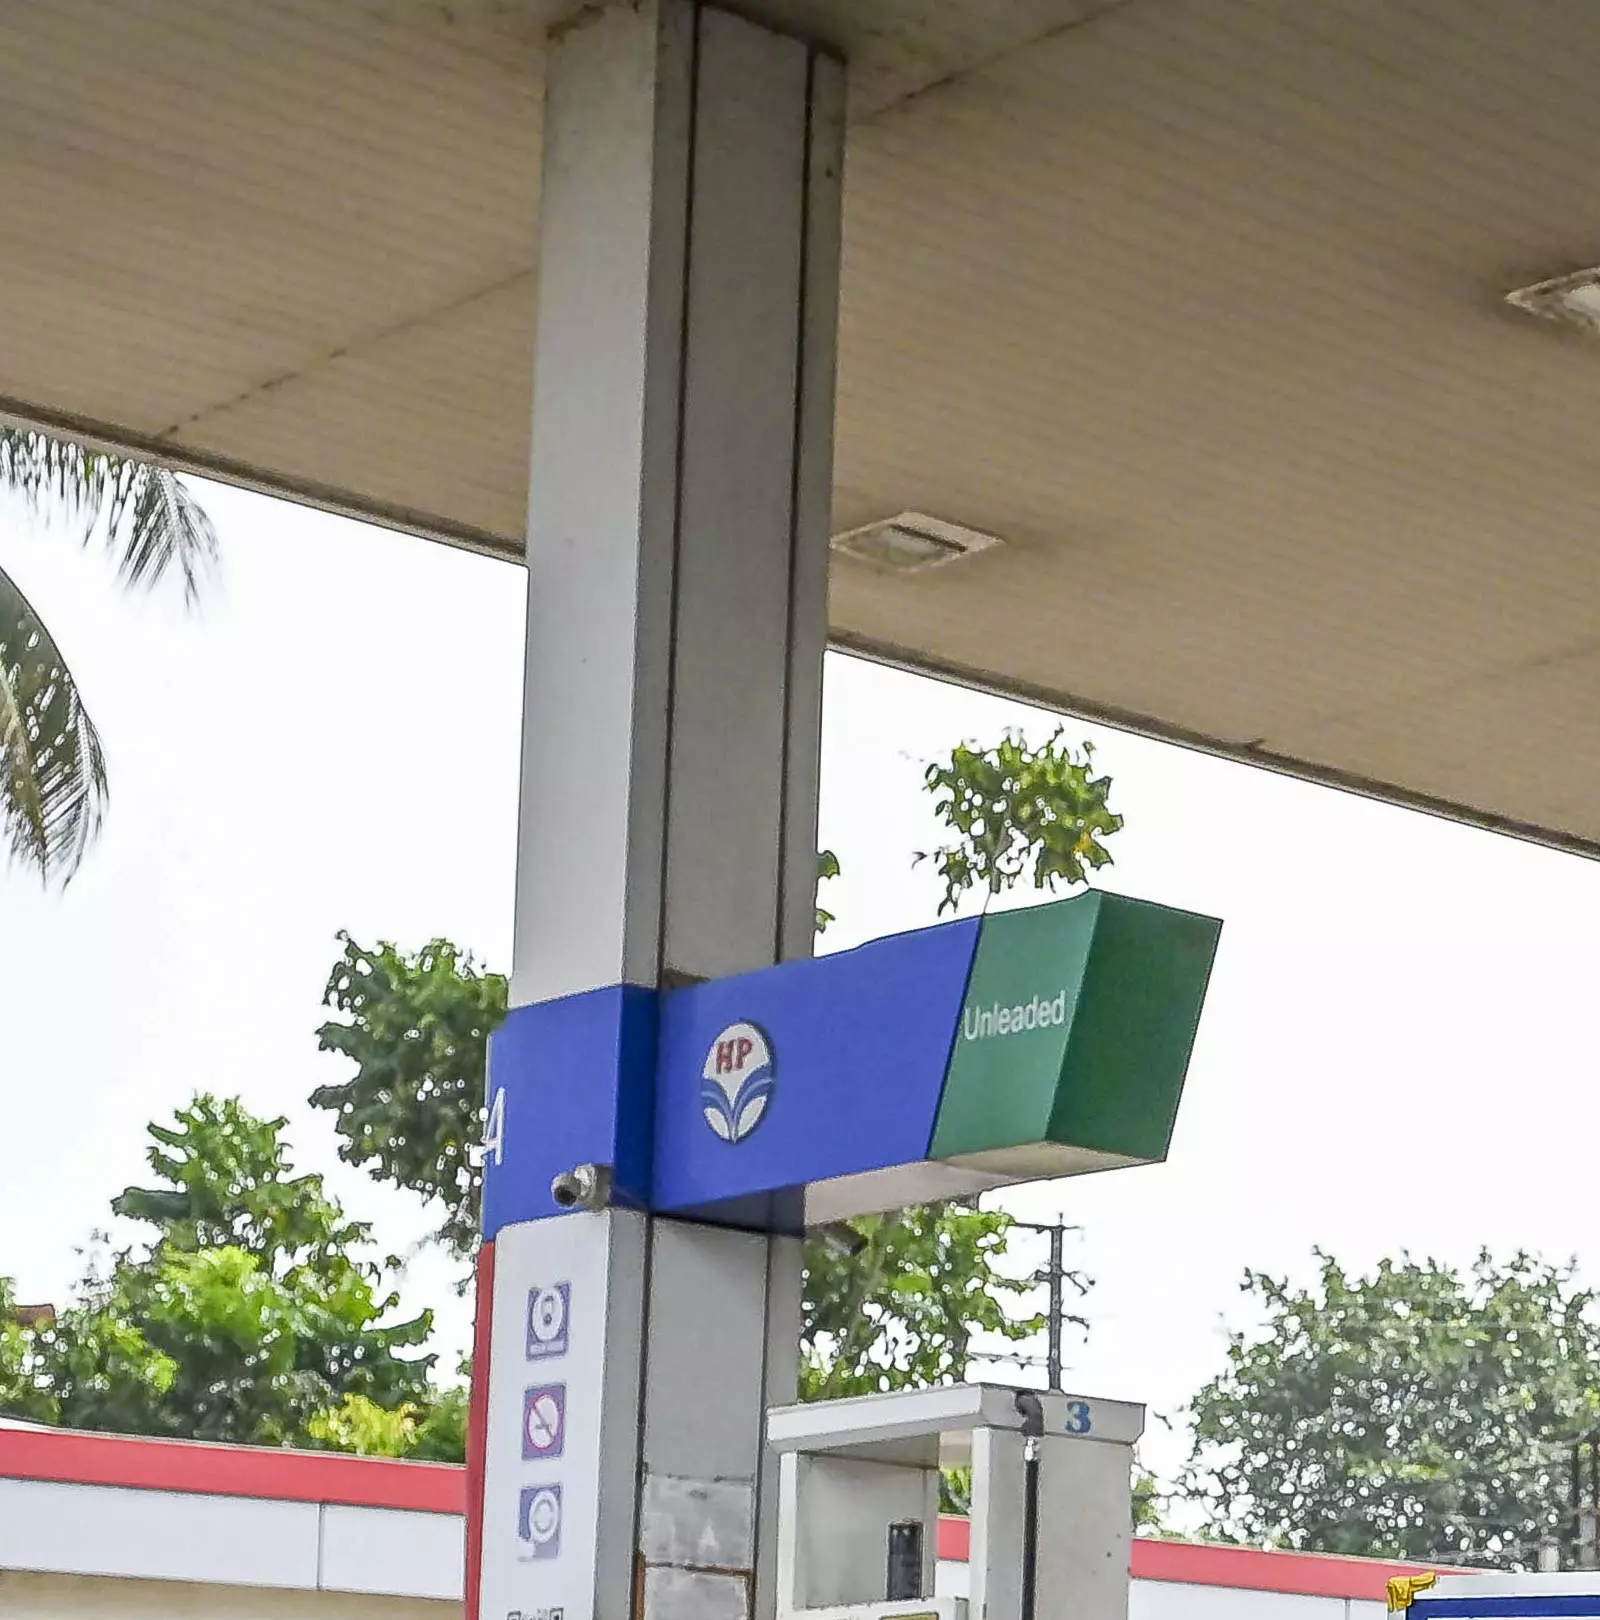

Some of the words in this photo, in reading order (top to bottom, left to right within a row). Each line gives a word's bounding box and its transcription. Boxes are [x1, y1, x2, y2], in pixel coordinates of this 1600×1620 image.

[963, 990, 1066, 1041] Unleaded
[714, 1035, 753, 1075] HP
[1064, 1400, 1092, 1434] 3
